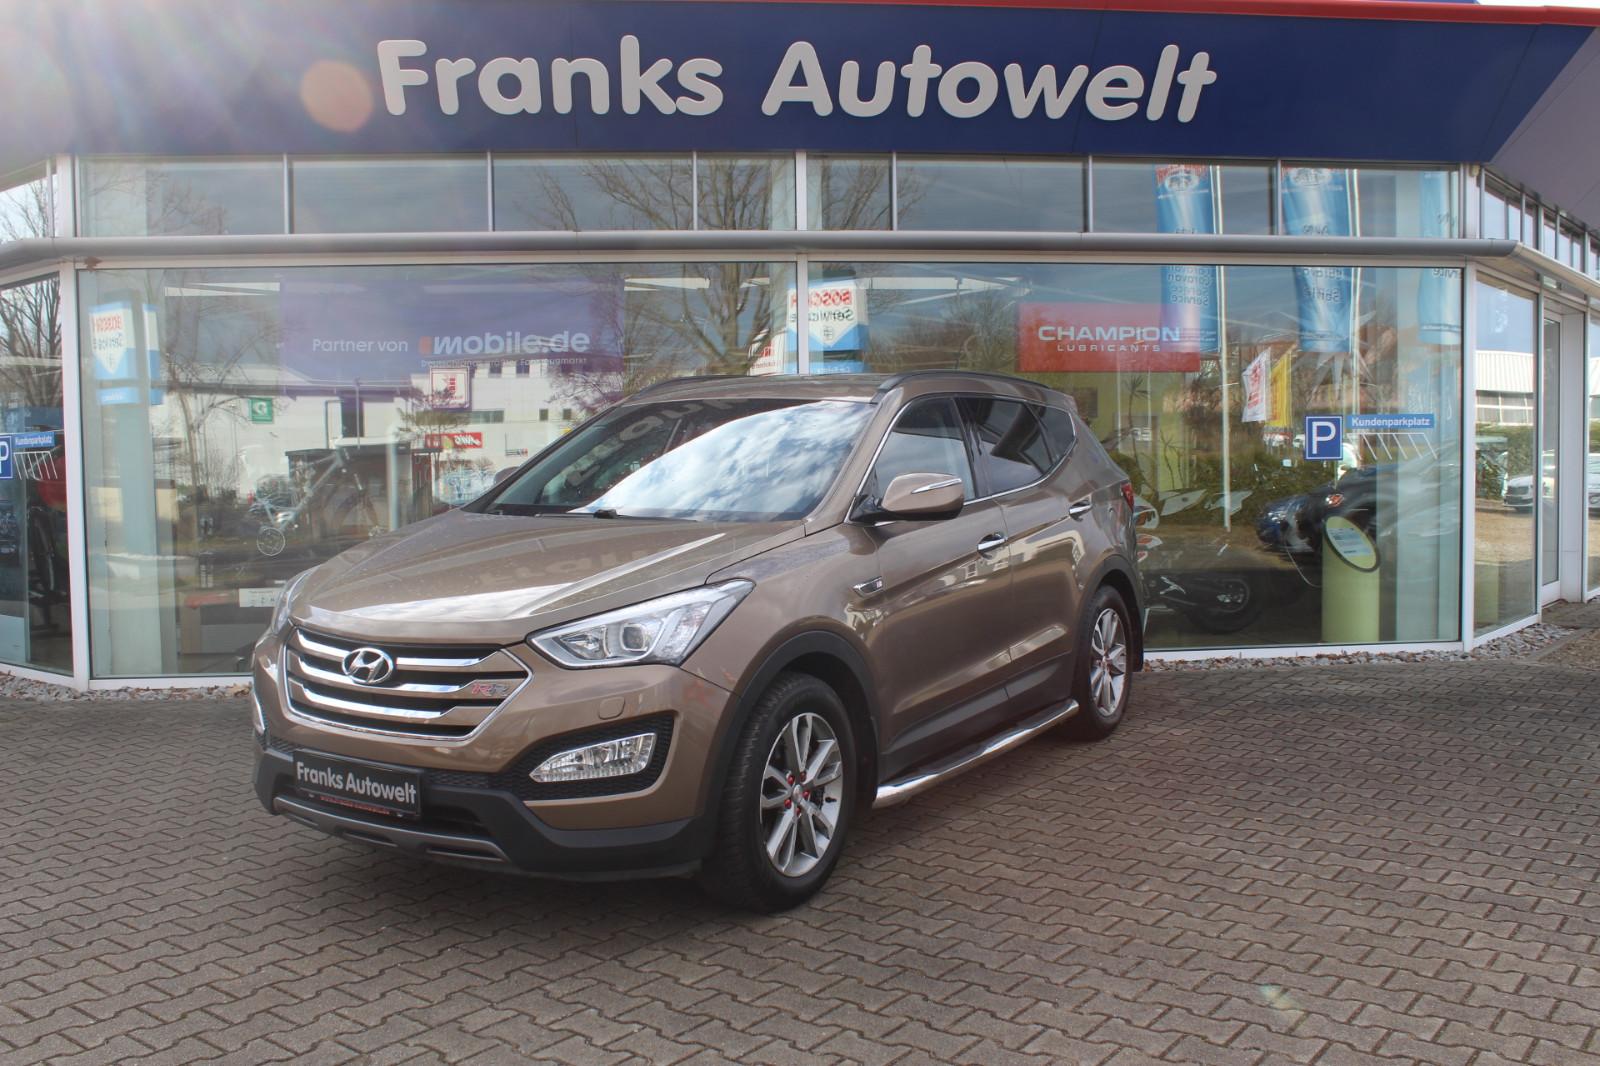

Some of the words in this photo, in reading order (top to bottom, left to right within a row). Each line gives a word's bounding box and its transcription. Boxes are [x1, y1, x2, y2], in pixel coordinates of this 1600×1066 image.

[377, 35, 724, 116] Franks
[761, 40, 1218, 123] Autowelt
[312, 339, 374, 352] Partner
[378, 340, 408, 352] von
[434, 331, 590, 355] mobile.de
[1038, 326, 1180, 342] CHAMPION
[1057, 344, 1161, 352] LUBRICANTS
[1311, 421, 1337, 454] P
[1351, 416, 1430, 427] Kundenparkplatz
[296, 761, 344, 789] Franks
[345, 772, 417, 804] Autowelt
